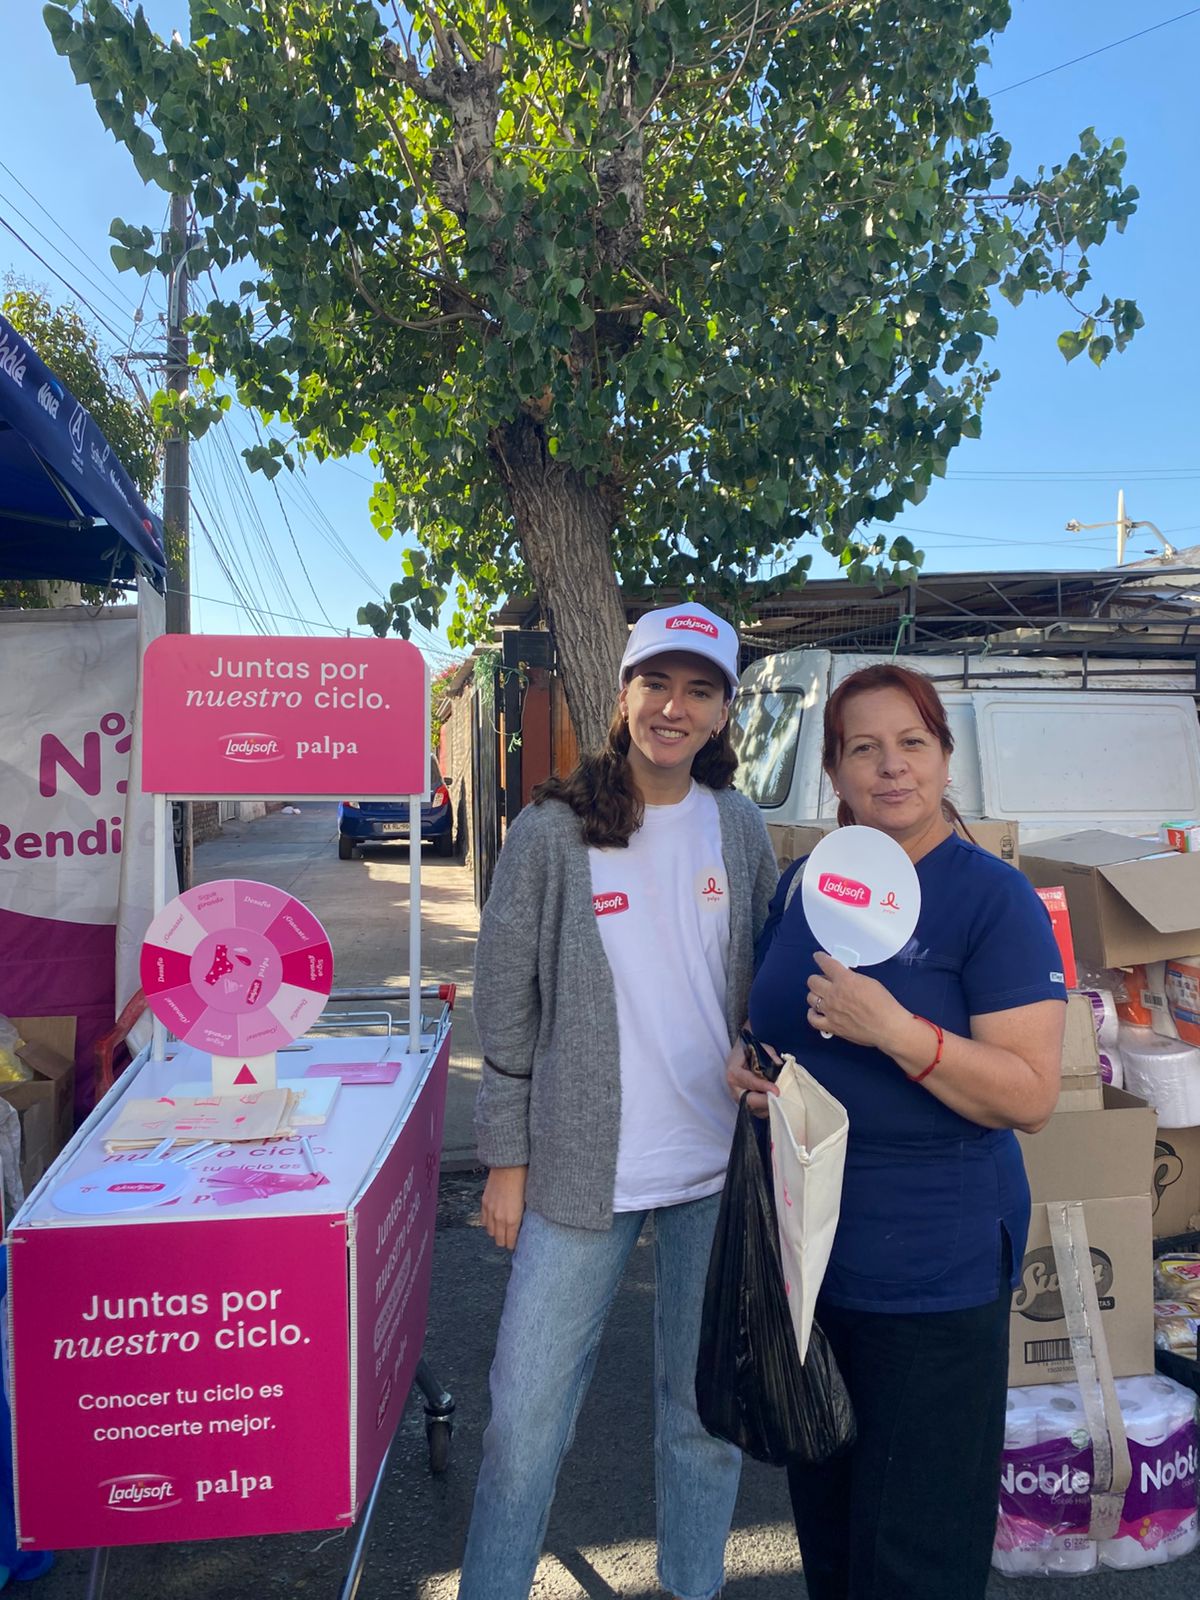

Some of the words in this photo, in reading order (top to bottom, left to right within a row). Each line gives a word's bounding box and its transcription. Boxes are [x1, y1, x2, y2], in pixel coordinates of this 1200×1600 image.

[37, 382, 60, 419] Nova
[671, 618, 714, 633] Ladysoft
[210, 657, 310, 679] Juntas
[320, 662, 368, 686] por
[185, 688, 303, 708] nuestro
[314, 687, 390, 710] ciclo.
[225, 739, 279, 755] Ladysoft
[296, 736, 358, 759] palpa
[824, 878, 865, 900] Ladysoft
[82, 1292, 209, 1321] Juntas
[222, 1288, 282, 1322] por
[53, 1329, 200, 1360] nuestro
[214, 1320, 311, 1350] ciclo.
[78, 1390, 170, 1410] Conocer
[176, 1388, 197, 1404] tu
[203, 1383, 254, 1402] ciclo
[259, 1384, 284, 1398] es
[93, 1418, 203, 1442] conocerte
[209, 1414, 276, 1437] mejor.
[196, 1470, 274, 1502] palpa
[1001, 1463, 1090, 1494] Noble
[108, 1482, 174, 1504] Ladysoft
